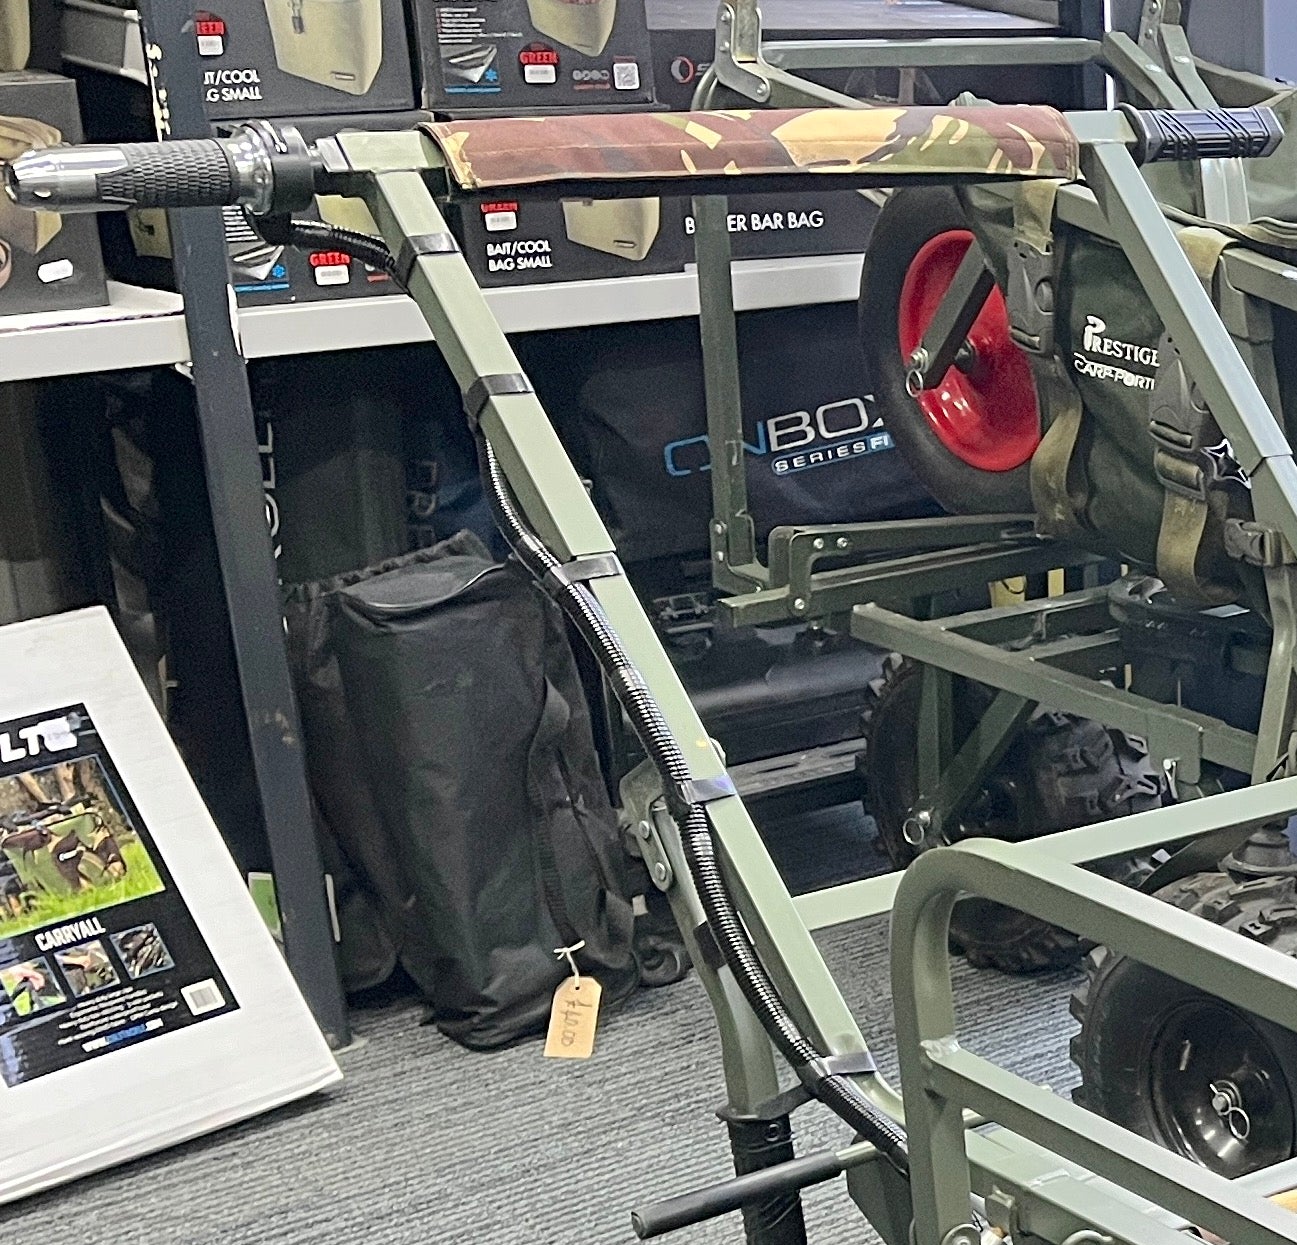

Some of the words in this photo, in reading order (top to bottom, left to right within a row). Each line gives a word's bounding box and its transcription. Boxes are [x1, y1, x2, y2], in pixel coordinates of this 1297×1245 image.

[203, 69, 261, 86] IT/COOL
[221, 86, 263, 101] SMALL
[685, 214, 748, 234] BER
[750, 212, 784, 231] BAR
[787, 210, 824, 229] BAG
[486, 239, 552, 257] BAIT/COOL
[488, 257, 516, 272] BAG
[516, 254, 553, 270] SMALL
[1073, 352, 1156, 391] CARP-PORT
[773, 440, 866, 472] SERIES
[35, 917, 106, 951] CARRYALL
